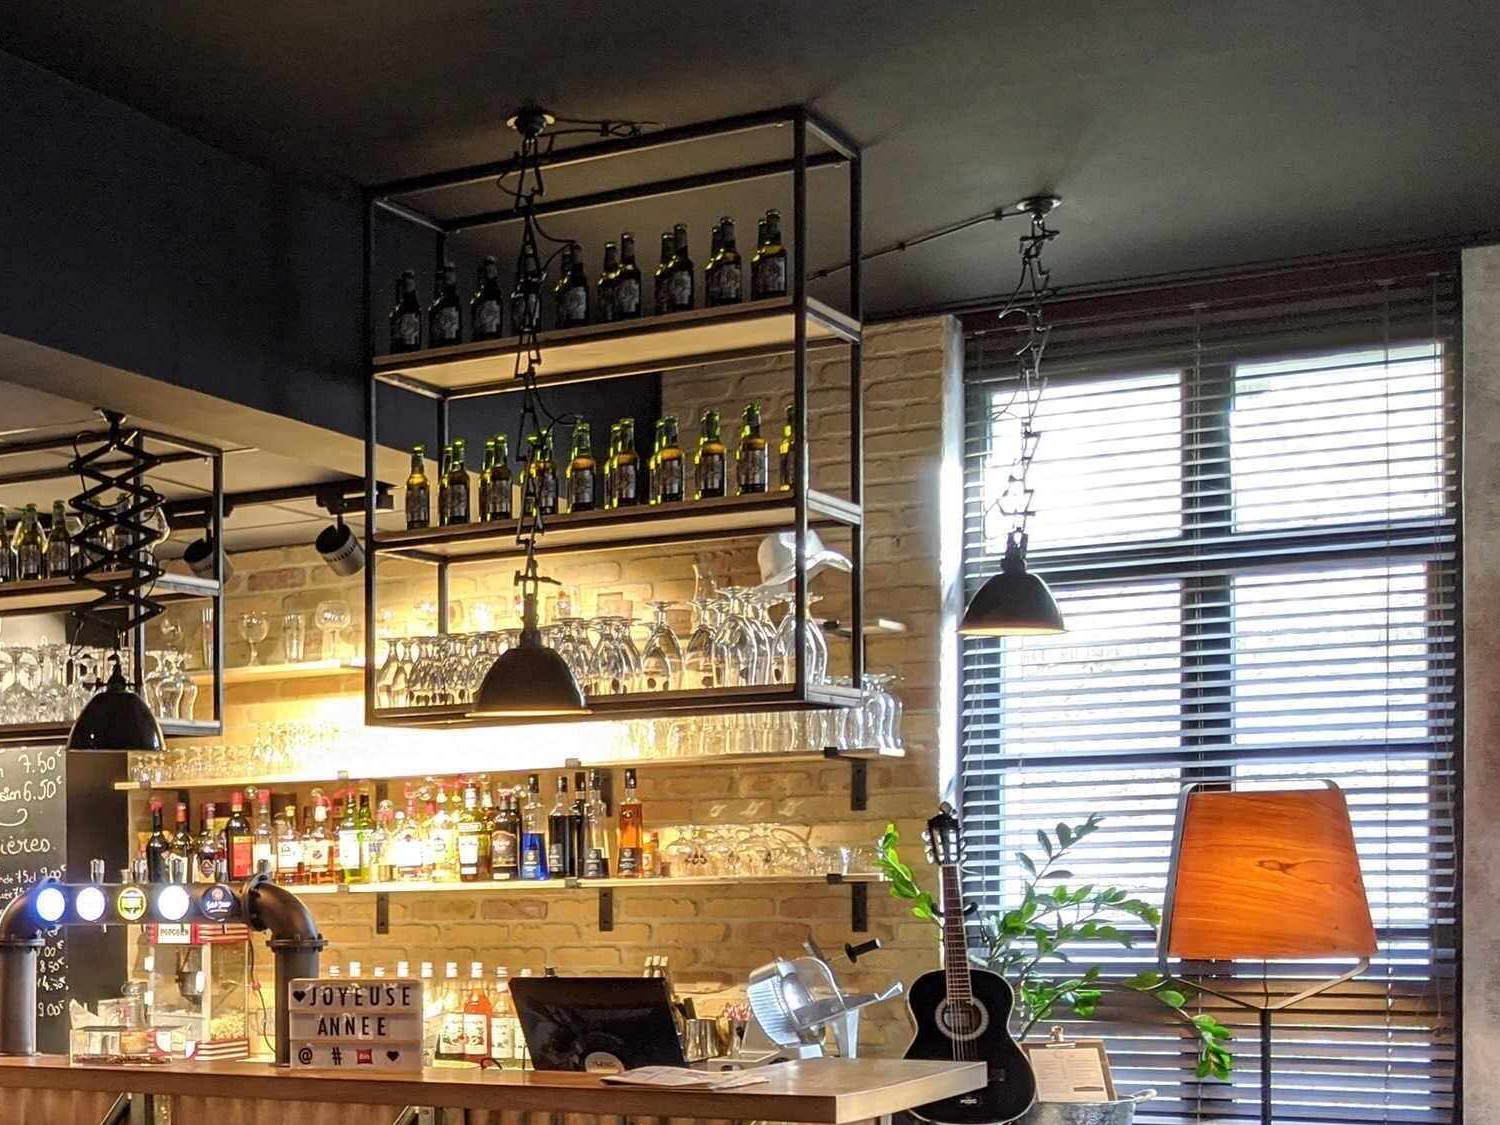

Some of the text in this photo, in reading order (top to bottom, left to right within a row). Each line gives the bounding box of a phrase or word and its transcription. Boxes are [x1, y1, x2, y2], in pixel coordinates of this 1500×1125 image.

[310, 986, 411, 1006] JOYEUSE
[317, 1016, 386, 1036] ANNEE
[298, 1047, 312, 1065] @
